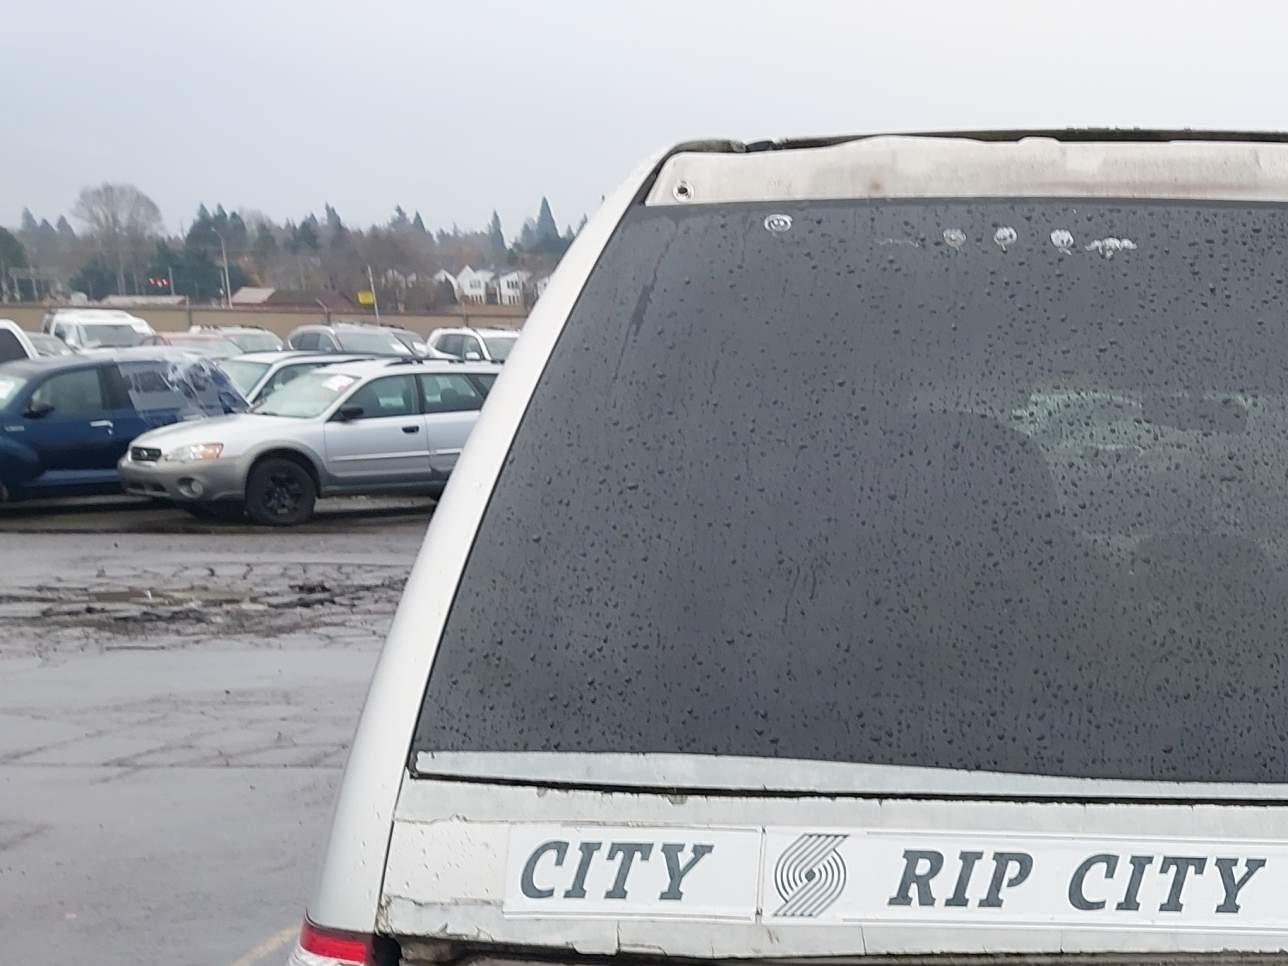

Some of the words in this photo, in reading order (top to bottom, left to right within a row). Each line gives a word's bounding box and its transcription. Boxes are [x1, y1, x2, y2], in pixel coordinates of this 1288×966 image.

[520, 840, 715, 901] CITY
[887, 849, 1034, 908] RIP
[1068, 853, 1267, 914] CITY
